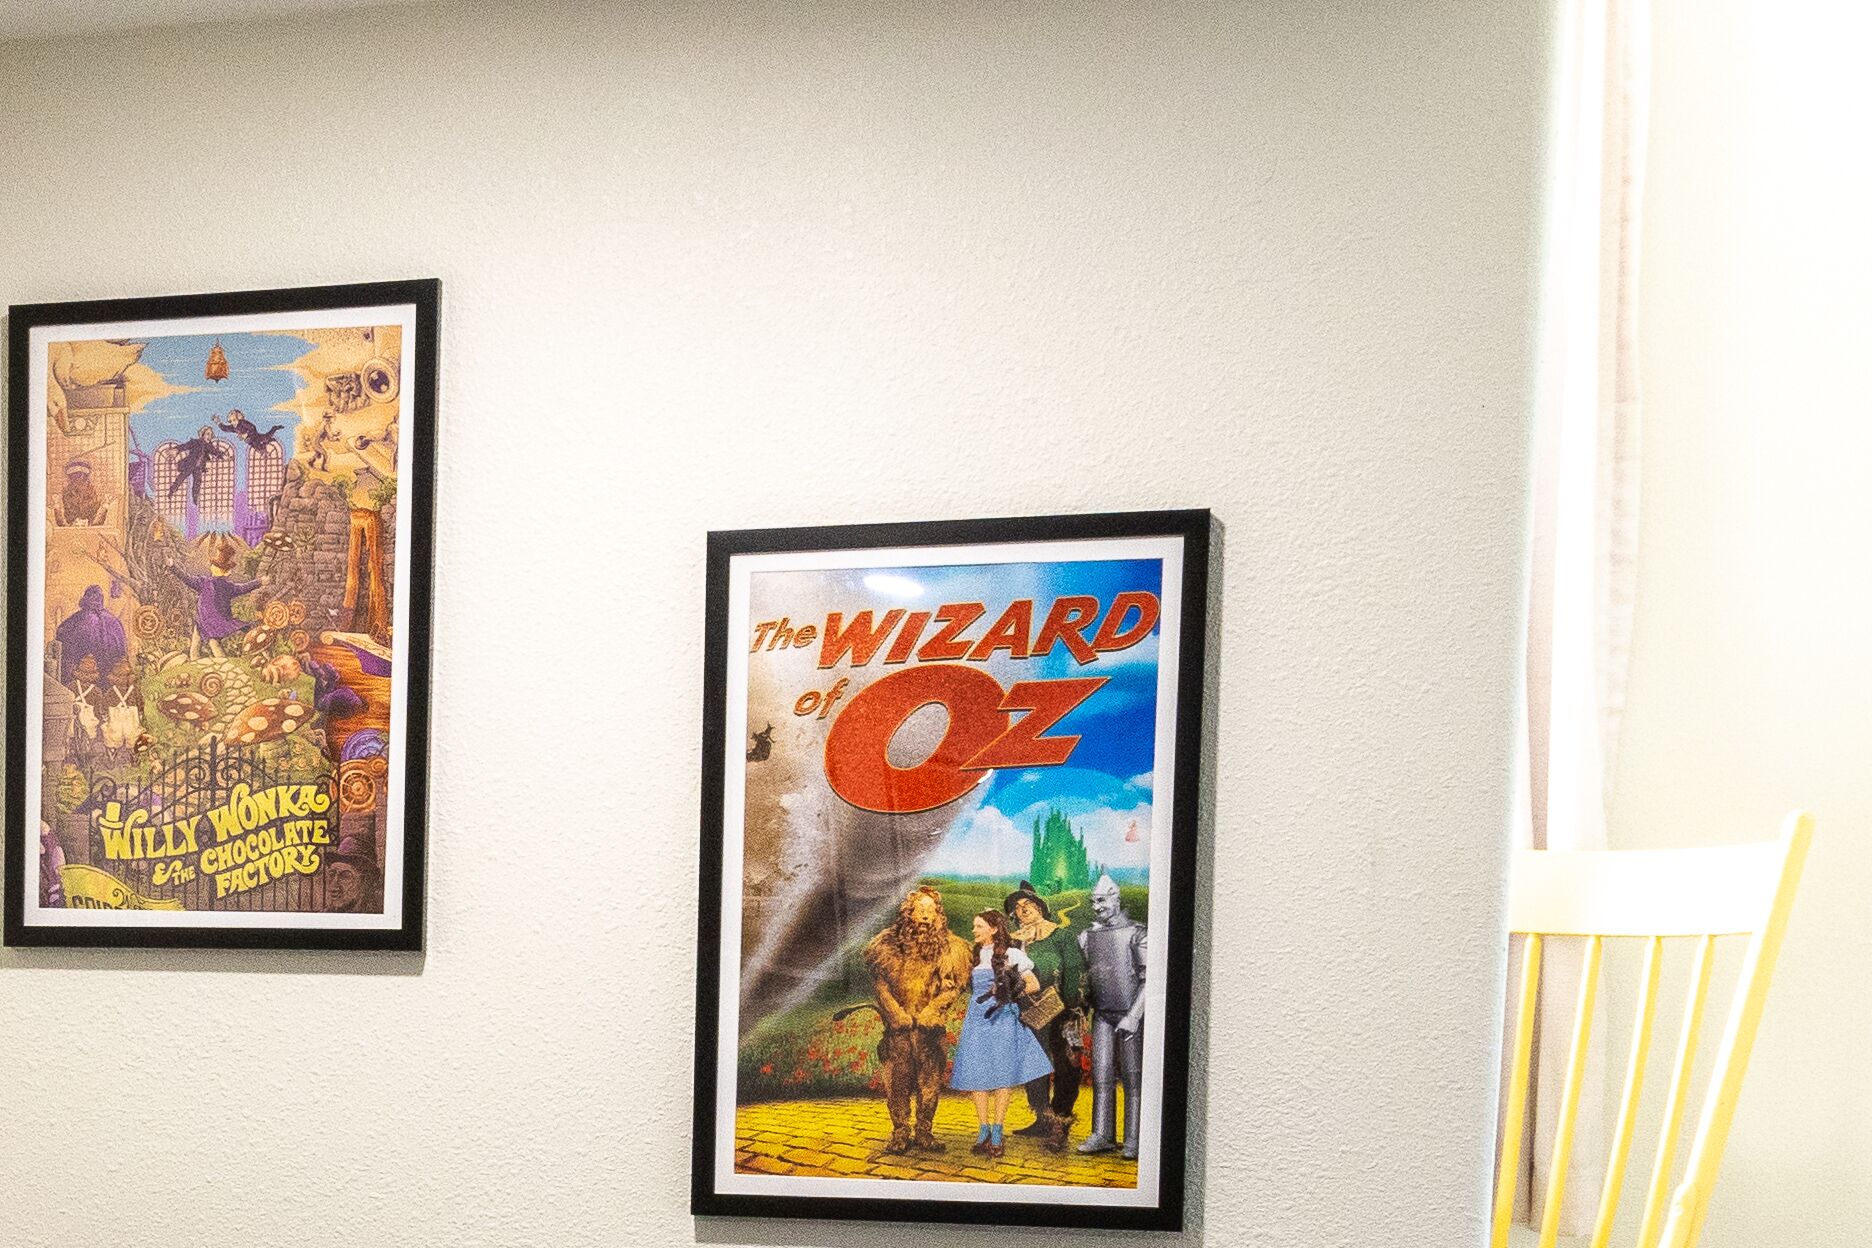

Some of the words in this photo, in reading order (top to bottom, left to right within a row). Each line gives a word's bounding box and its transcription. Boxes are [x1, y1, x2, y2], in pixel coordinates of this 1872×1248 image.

[749, 617, 818, 654] The
[816, 591, 1161, 669] WIZARD
[793, 677, 849, 720] of
[99, 806, 202, 860] WILLY
[207, 783, 330, 843] WONKA
[173, 865, 196, 886] THE
[200, 820, 331, 875] CHOCOLATE
[215, 845, 320, 898] FACTORY
